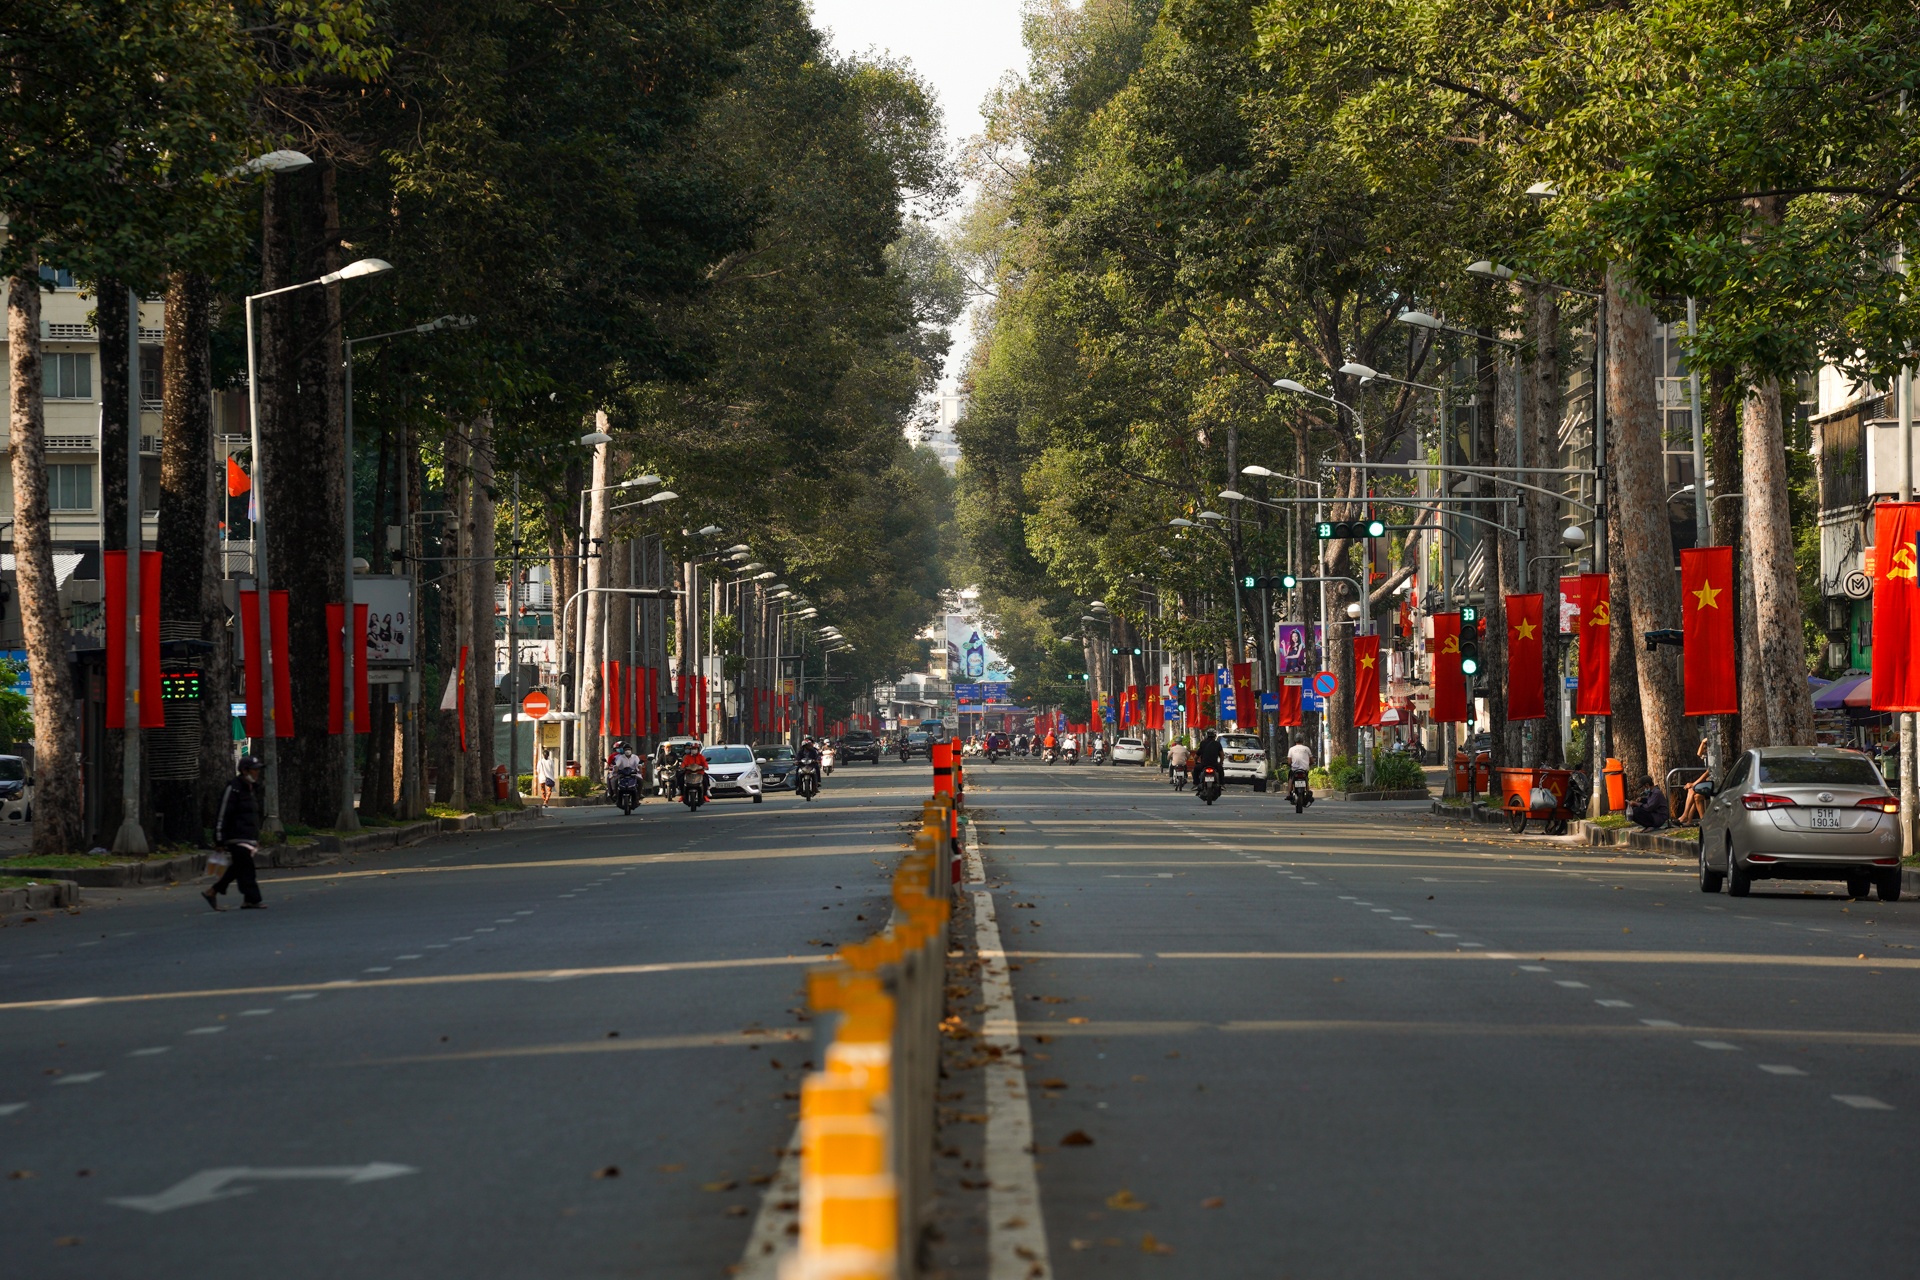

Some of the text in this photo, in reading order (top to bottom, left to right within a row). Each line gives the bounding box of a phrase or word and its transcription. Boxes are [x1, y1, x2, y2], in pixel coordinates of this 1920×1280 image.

[1319, 524, 1331, 537] 33
[1245, 577, 1255, 587] 33
[1463, 608, 1475, 621] 33
[1817, 808, 1834, 818] 51H
[1812, 818, 1840, 828] 190.34
